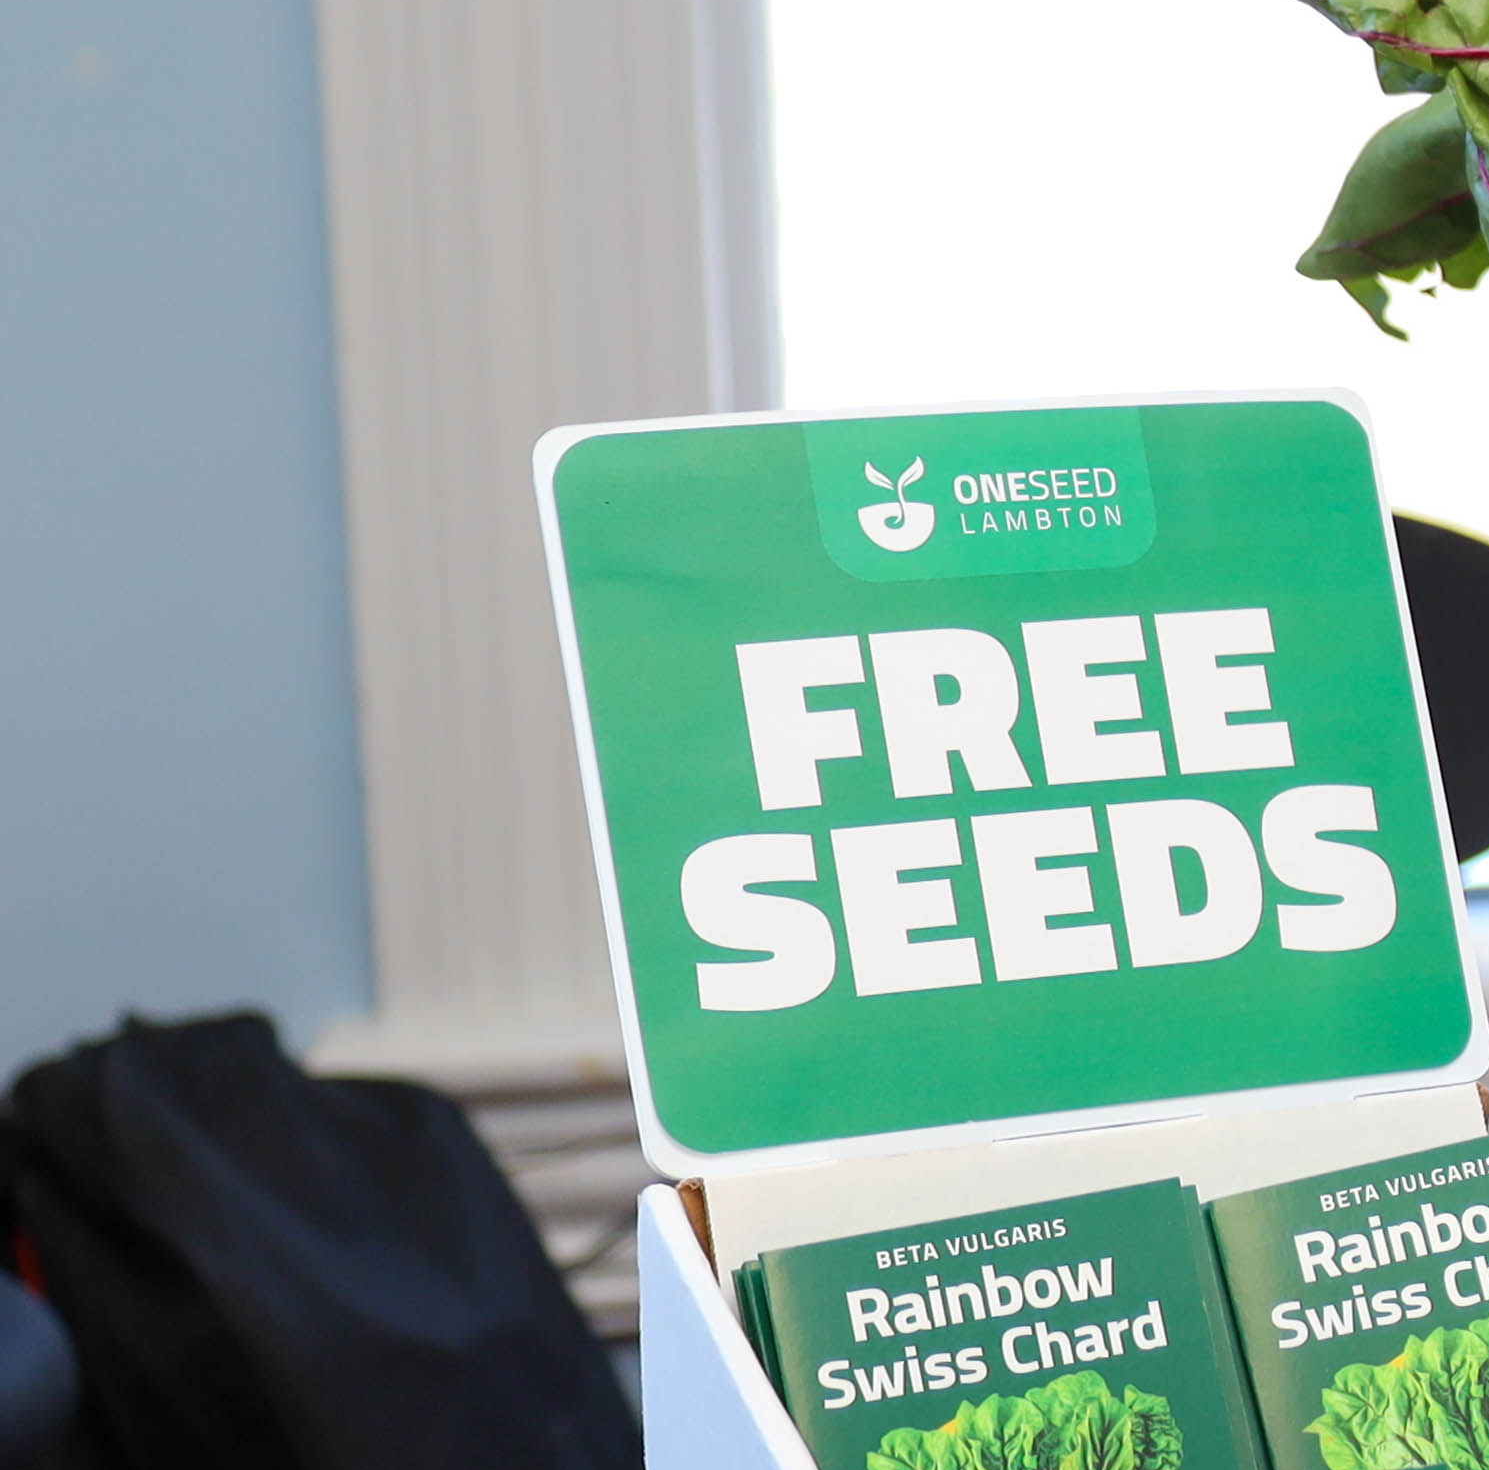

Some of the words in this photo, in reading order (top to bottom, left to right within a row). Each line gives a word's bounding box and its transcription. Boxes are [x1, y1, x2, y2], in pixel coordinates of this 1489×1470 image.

[953, 467, 1117, 505] ONESEED
[960, 504, 1122, 535] LAMBTON
[734, 607, 1296, 812] FREE
[679, 783, 1398, 1013] SEEDS
[1318, 1183, 1381, 1213] BETA
[875, 1241, 940, 1270] BETA
[944, 1217, 1067, 1257] VULGARIS
[845, 1256, 1114, 1343] Rainbow
[1270, 1281, 1433, 1350] Swiss
[817, 1344, 989, 1410] Swiss
[1001, 1299, 1169, 1375] Chard
